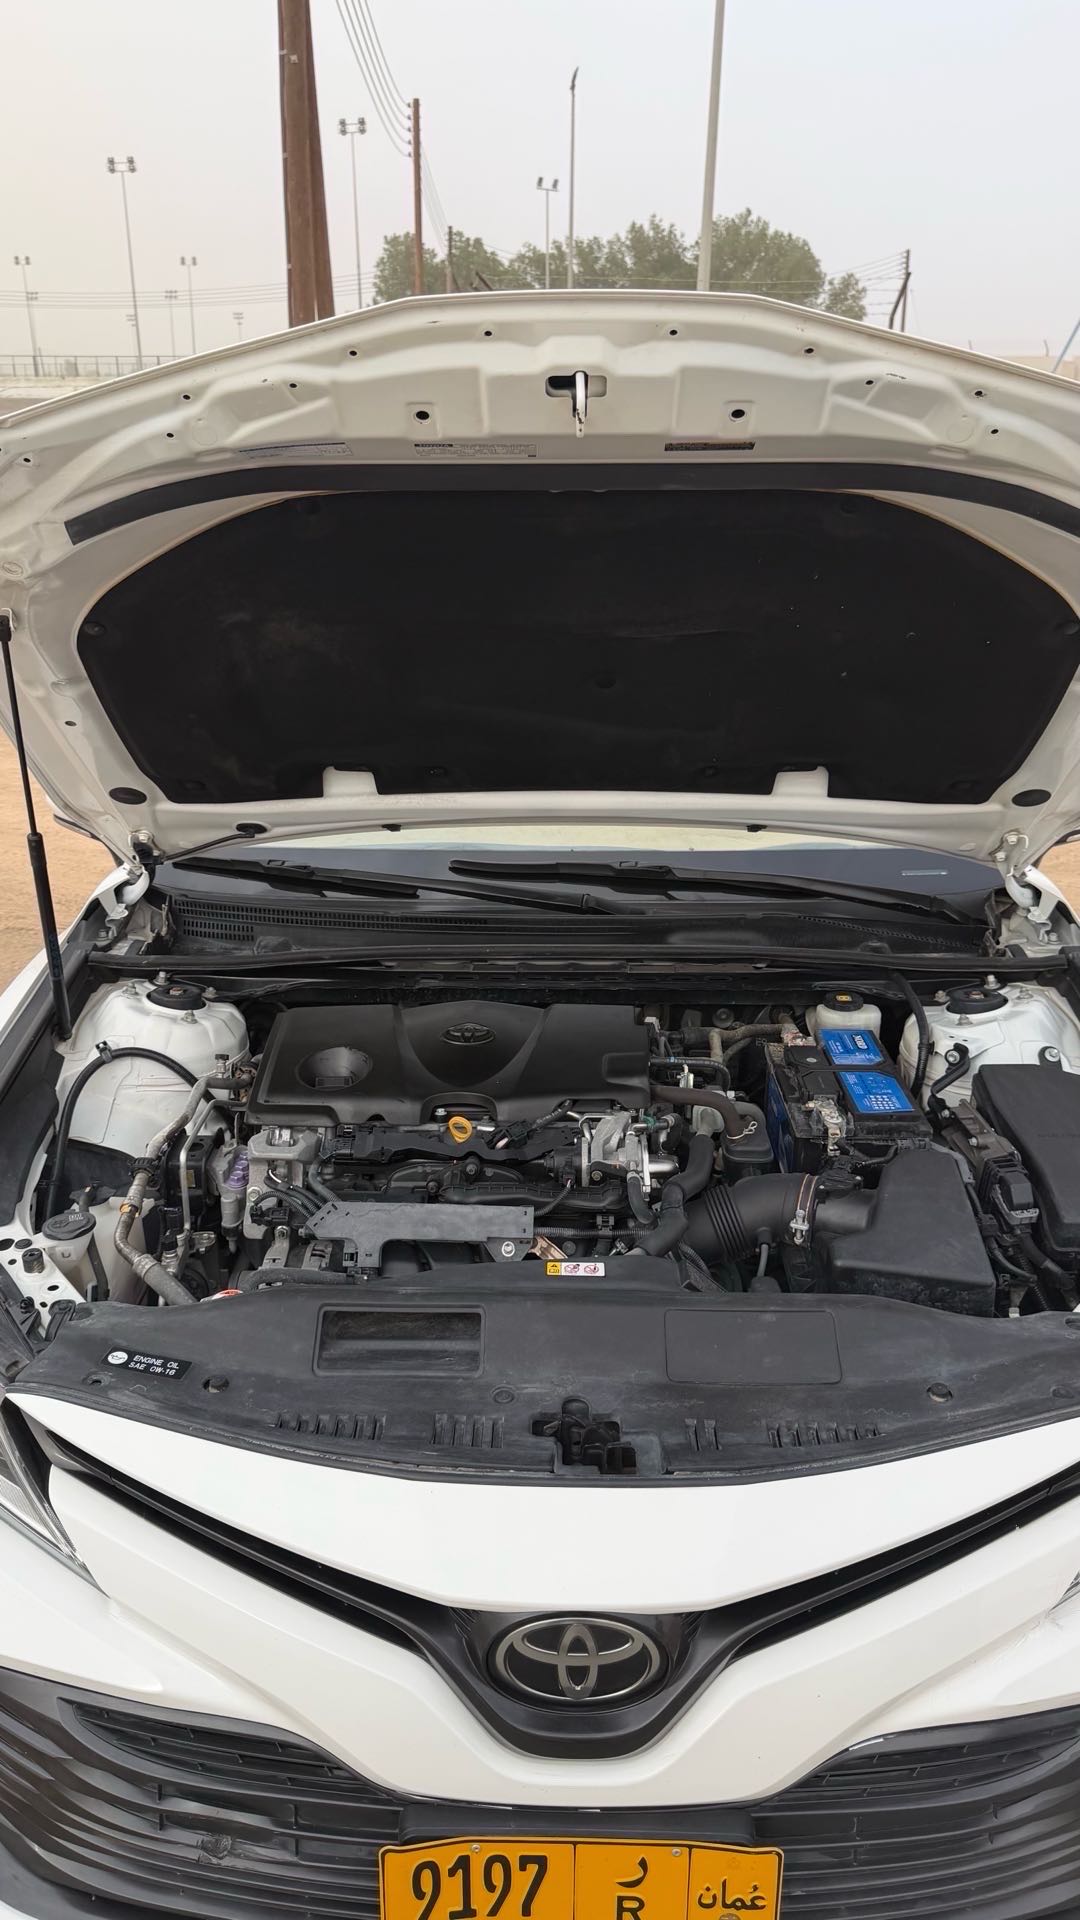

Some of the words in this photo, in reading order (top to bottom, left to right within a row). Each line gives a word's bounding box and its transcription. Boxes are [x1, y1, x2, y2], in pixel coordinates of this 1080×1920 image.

[128, 1362, 147, 1370] SAE
[133, 1355, 164, 1366] ENGINE
[167, 1361, 179, 1369] OIL
[615, 1856, 648, 1888] ر
[411, 1854, 548, 1920] 9197
[617, 1895, 646, 1920] R
